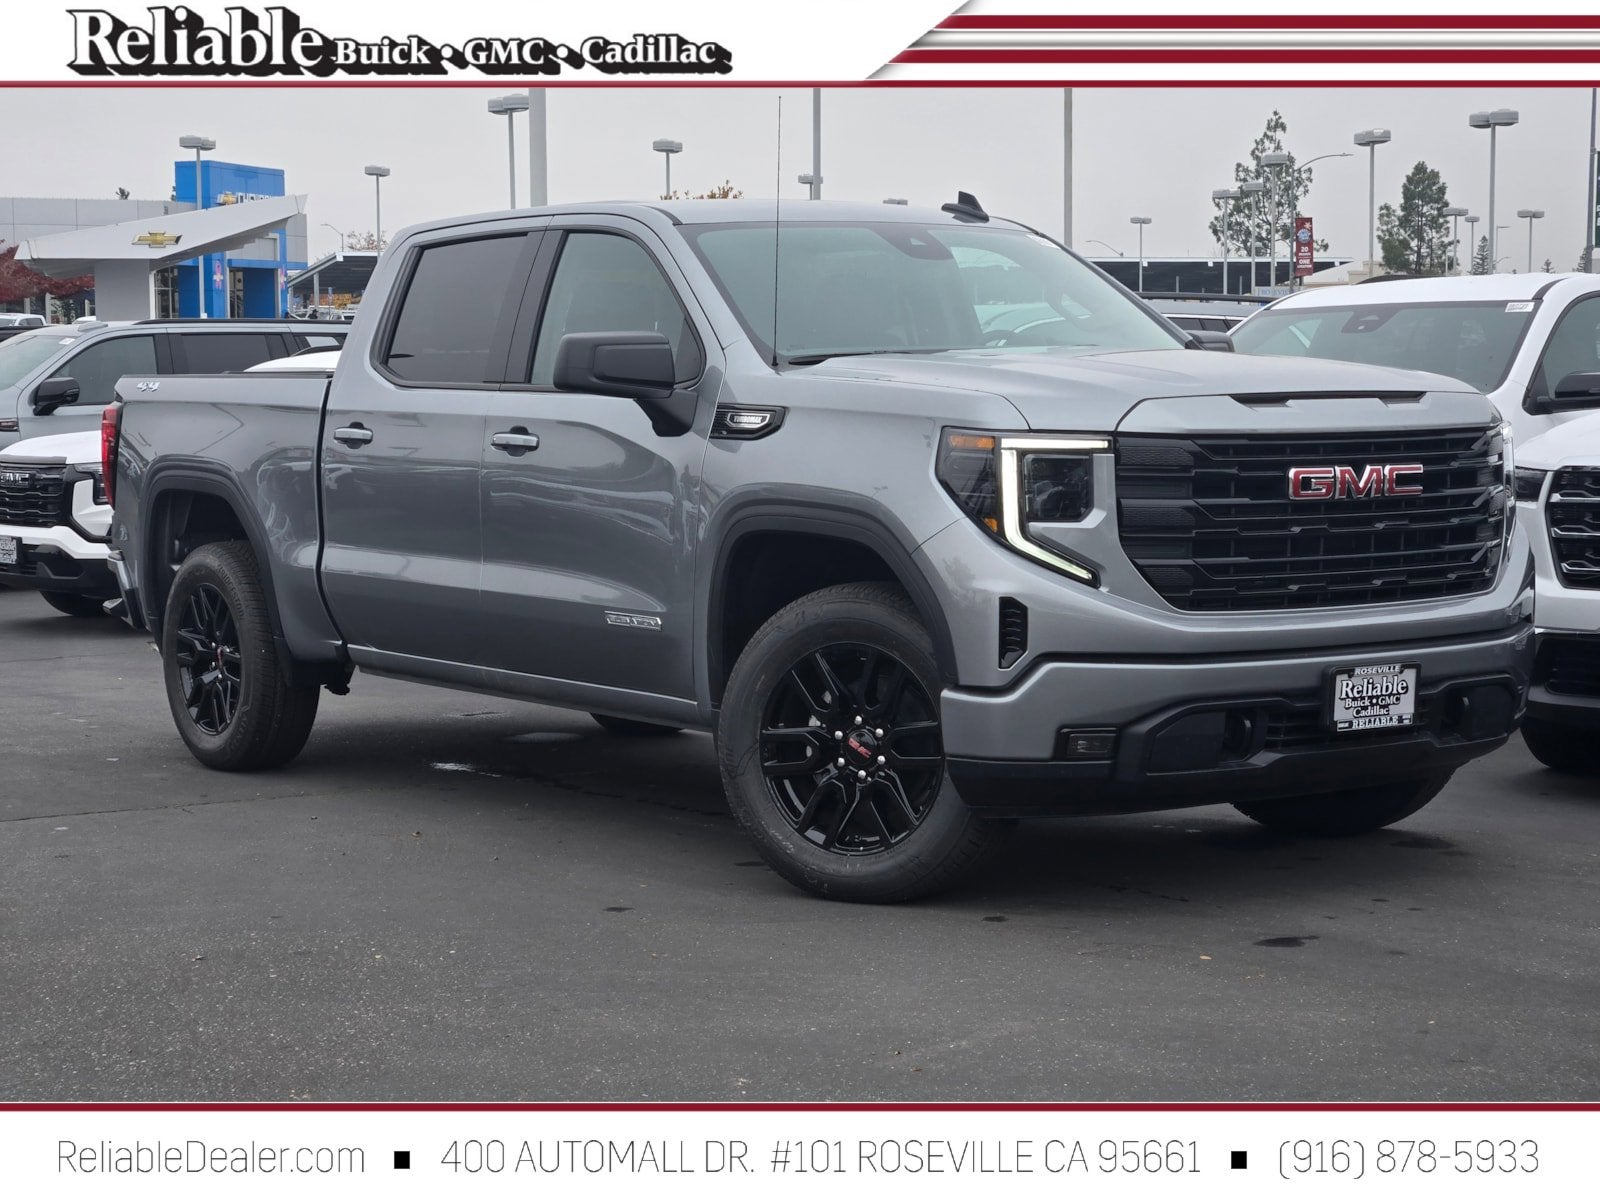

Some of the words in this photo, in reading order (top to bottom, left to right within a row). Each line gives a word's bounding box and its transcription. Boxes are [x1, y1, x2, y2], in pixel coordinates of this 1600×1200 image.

[1288, 464, 1424, 500] GMC
[1355, 666, 1400, 675] ROSEVILLE
[1339, 675, 1409, 699] Reliable
[1345, 697, 1371, 708] Buick
[1378, 695, 1400, 705] GMC
[1352, 704, 1390, 718] Cadillac
[1352, 716, 1399, 729] RELIABLE
